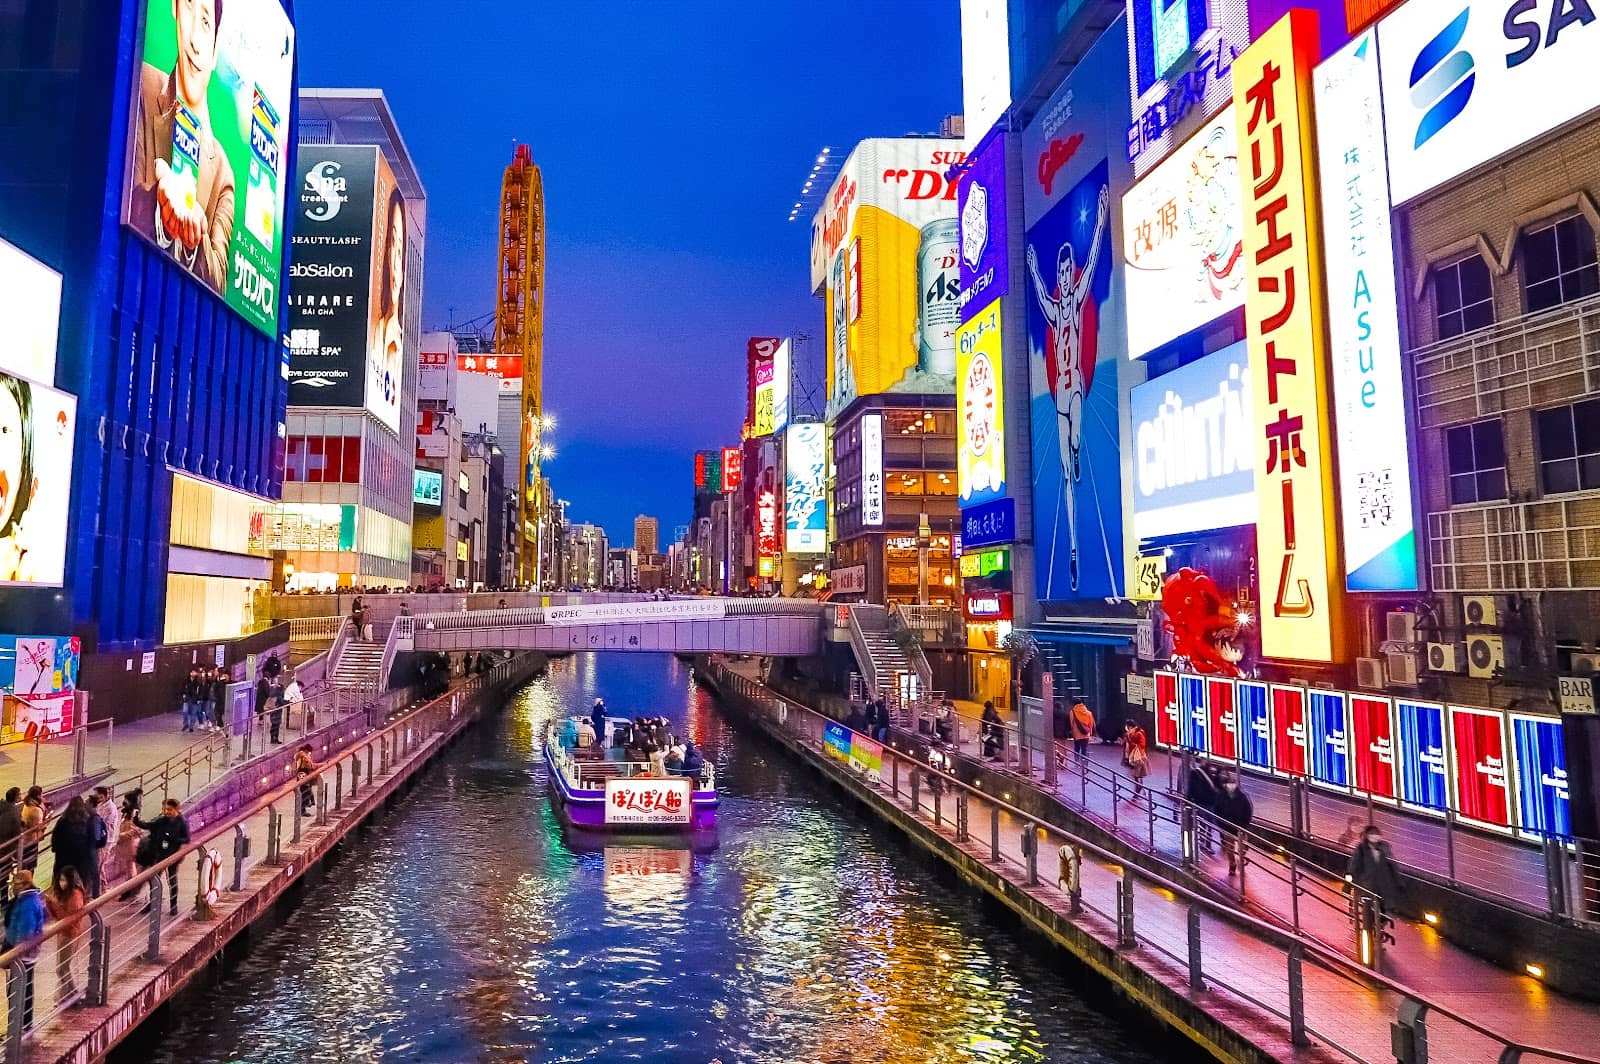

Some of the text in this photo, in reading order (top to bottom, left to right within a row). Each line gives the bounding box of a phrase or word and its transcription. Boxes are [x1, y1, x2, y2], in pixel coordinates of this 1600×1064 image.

[305, 171, 346, 191] Spa
[1246, 60, 1314, 618] オリエントホーム
[1062, 325, 1072, 390] グリコ
[303, 370, 349, 378] corporation
[1560, 680, 1593, 698] BAR
[612, 788, 682, 814] ぽんぽん船
